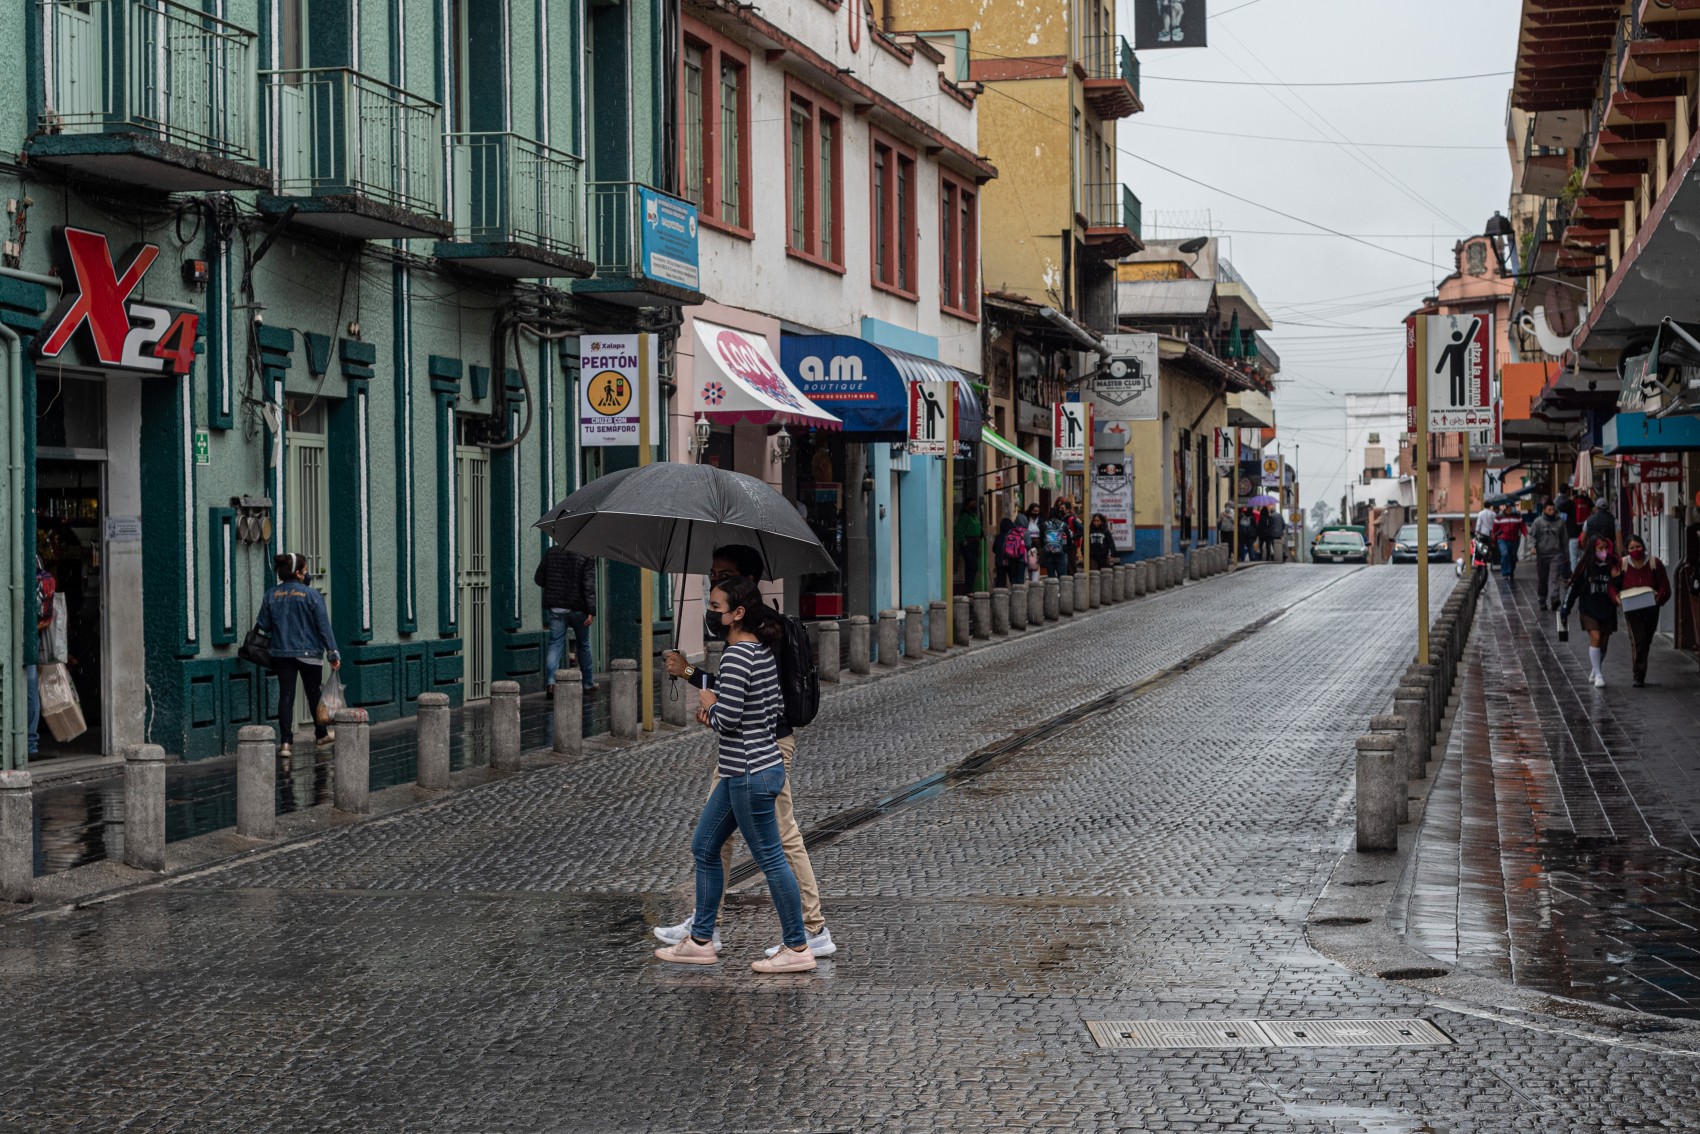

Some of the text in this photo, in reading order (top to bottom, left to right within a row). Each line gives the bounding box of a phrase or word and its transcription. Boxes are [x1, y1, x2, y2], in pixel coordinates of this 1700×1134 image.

[41, 226, 200, 375] X24
[581, 351, 637, 369] PEATÓN
[718, 340, 773, 380] LOOK
[1473, 341, 1483, 407] alza la mano
[803, 383, 864, 391] BOUTIQUE
[591, 416, 627, 424] CRUZA CON
[596, 423, 636, 433] SEMÁFORO
